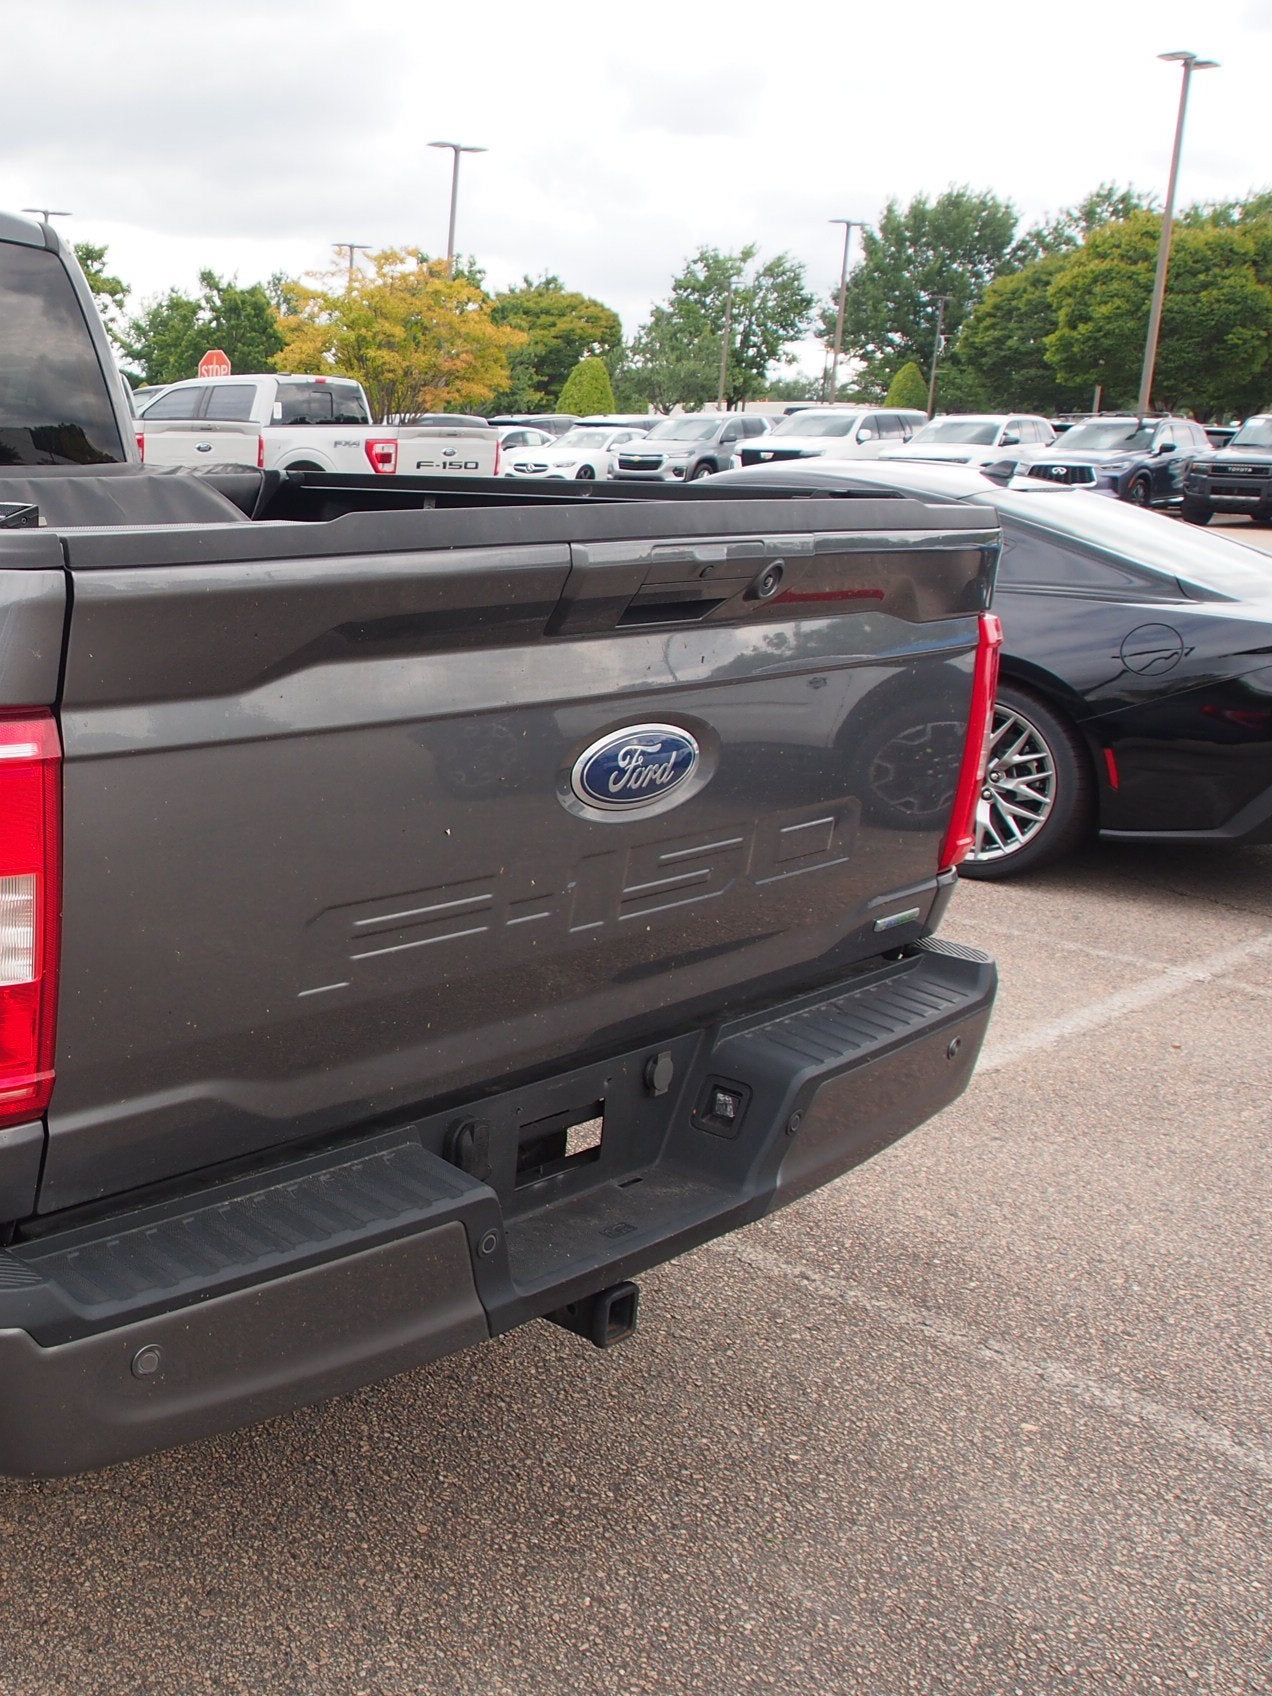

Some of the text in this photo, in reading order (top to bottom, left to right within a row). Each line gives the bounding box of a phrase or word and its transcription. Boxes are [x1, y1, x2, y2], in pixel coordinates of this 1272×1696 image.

[201, 365, 228, 378] STOP
[333, 440, 360, 448] FX4
[416, 461, 479, 470] F-150
[608, 743, 678, 793] Ford
